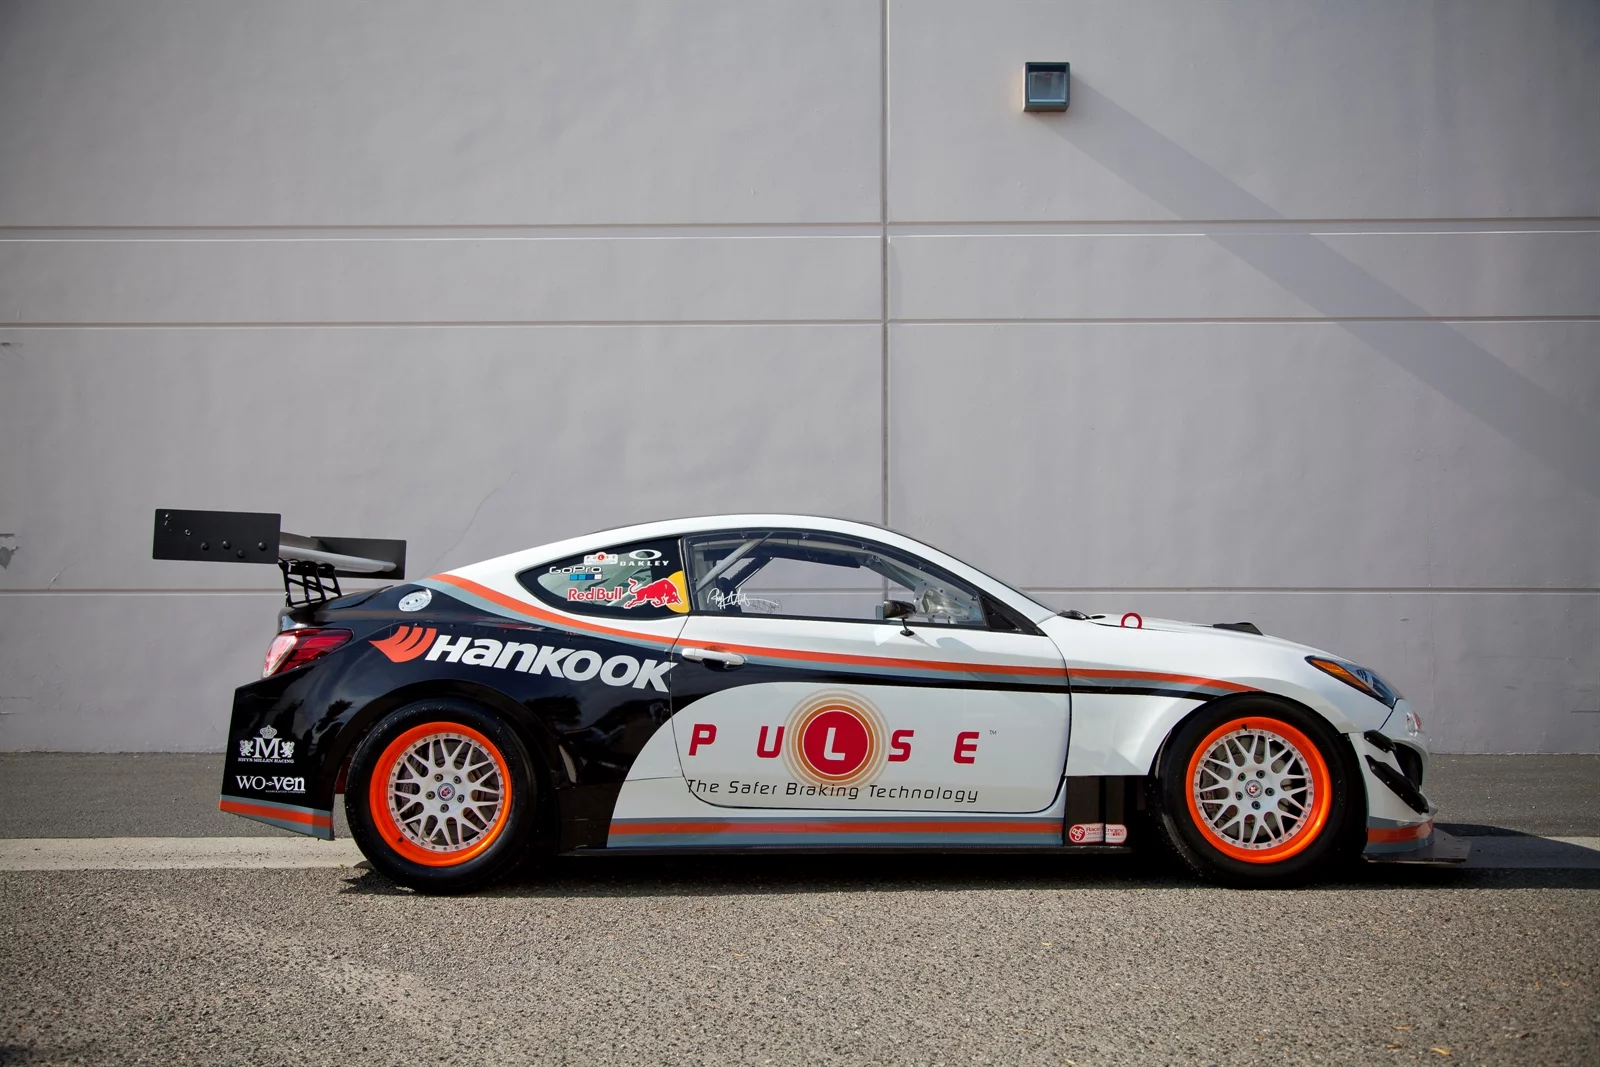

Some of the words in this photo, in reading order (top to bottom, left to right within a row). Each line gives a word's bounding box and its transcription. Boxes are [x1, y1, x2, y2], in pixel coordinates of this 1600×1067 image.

[549, 566, 602, 574] GoPro
[567, 587, 595, 601] Red
[595, 586, 623, 600] Bull
[252, 737, 282, 758] M
[687, 779, 720, 793] The
[728, 780, 778, 795] Safer
[786, 782, 859, 800] Braking
[869, 784, 980, 804] Technology
